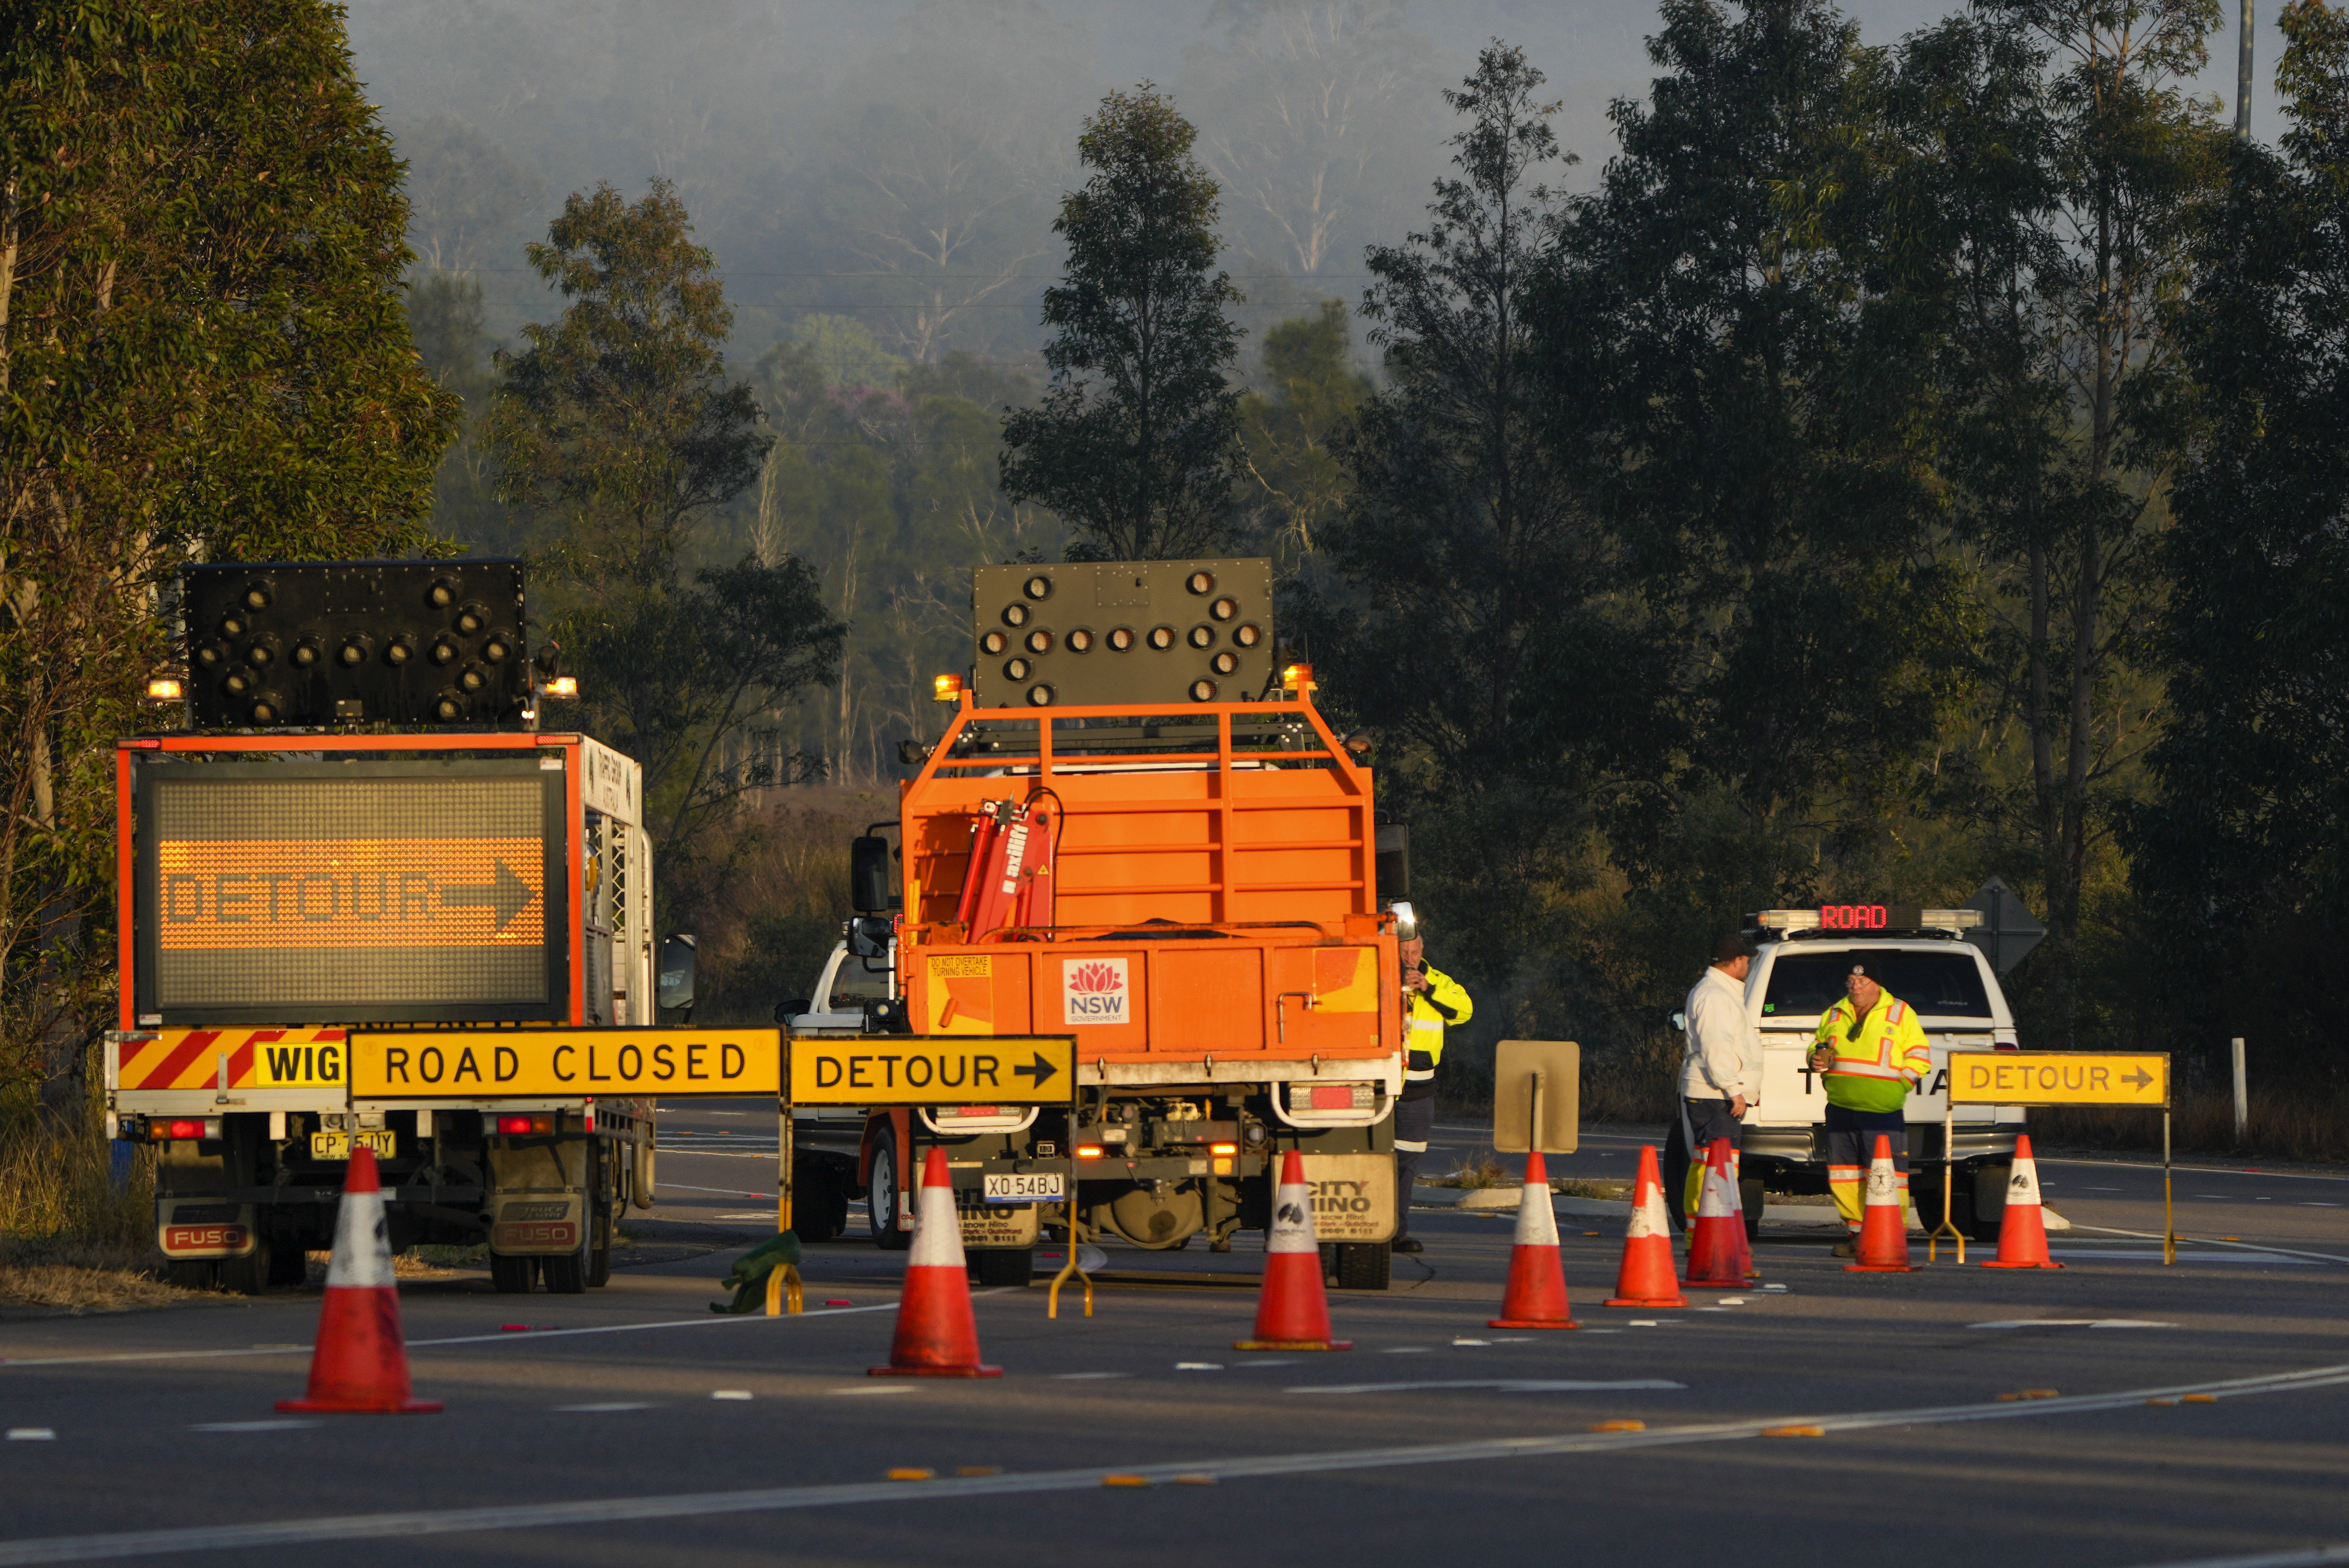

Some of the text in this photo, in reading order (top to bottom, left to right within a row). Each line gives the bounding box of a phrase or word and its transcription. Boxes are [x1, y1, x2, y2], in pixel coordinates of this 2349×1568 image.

[168, 871, 438, 921] DETOUR
[1821, 905, 1886, 928] ROAD
[931, 956, 987, 967] DO NOT OVERTAKE
[933, 965, 986, 976] TURNING VEHICLE
[1071, 997, 1122, 1014] NSW
[386, 1044, 745, 1083] ROAD CLOSED
[816, 1055, 999, 1088] DETOUR
[1971, 1065, 2109, 1091] DETOUR
[174, 1230, 240, 1245] FUSO
[505, 1227, 569, 1240] FUSO
